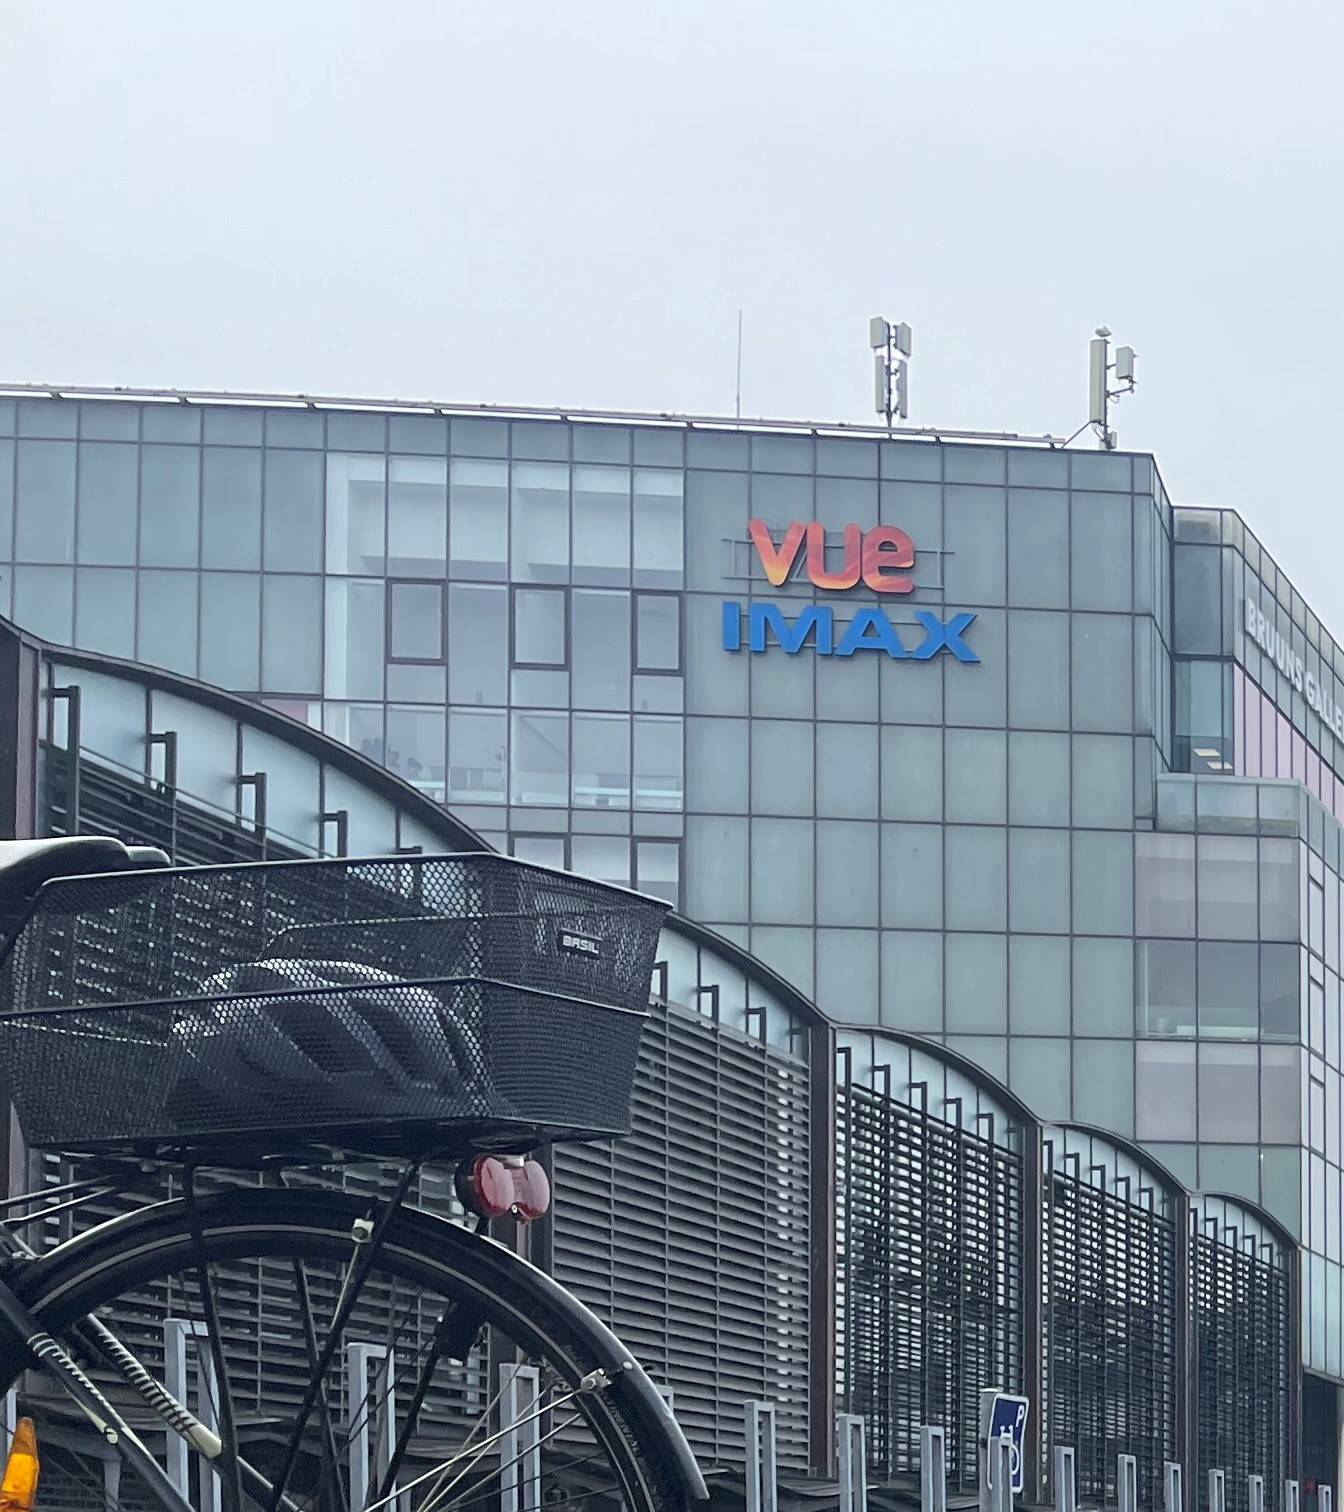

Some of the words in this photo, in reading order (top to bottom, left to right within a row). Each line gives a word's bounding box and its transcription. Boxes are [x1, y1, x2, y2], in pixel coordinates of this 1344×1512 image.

[722, 601, 981, 663] IMAX
[562, 935, 599, 954] BASIL
[1015, 1404, 1025, 1428] P
